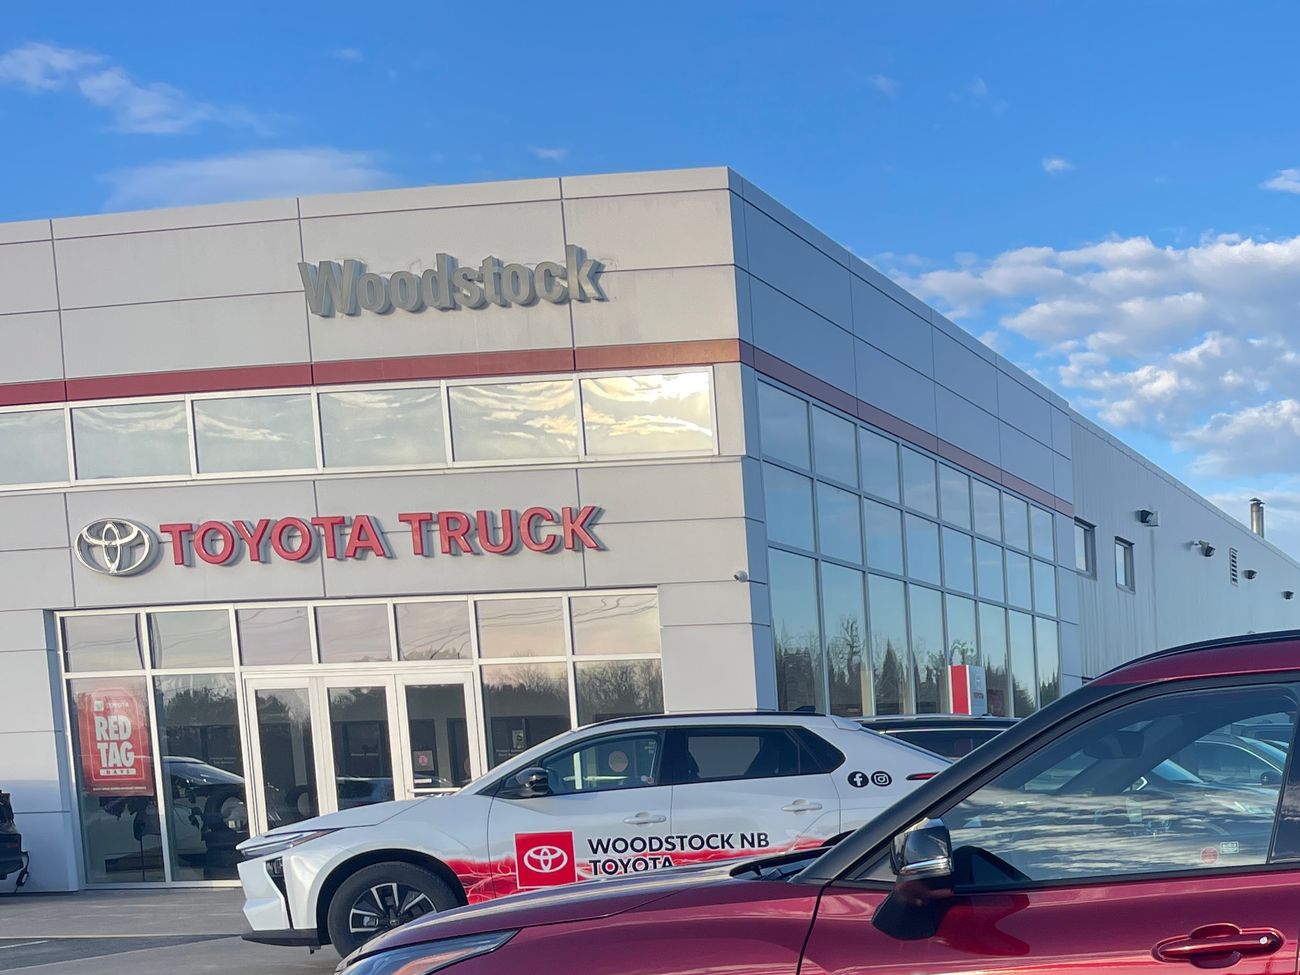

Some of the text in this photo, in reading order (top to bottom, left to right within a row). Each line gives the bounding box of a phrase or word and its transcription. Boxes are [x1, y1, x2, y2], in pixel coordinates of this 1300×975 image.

[297, 244, 606, 316] Woodstock
[160, 505, 601, 566] TOYOTA TRUCK
[94, 714, 132, 741] RED
[97, 741, 135, 767] TAG
[588, 832, 770, 854] WOODSTOCK NB
[589, 856, 674, 876] TOYOTA
